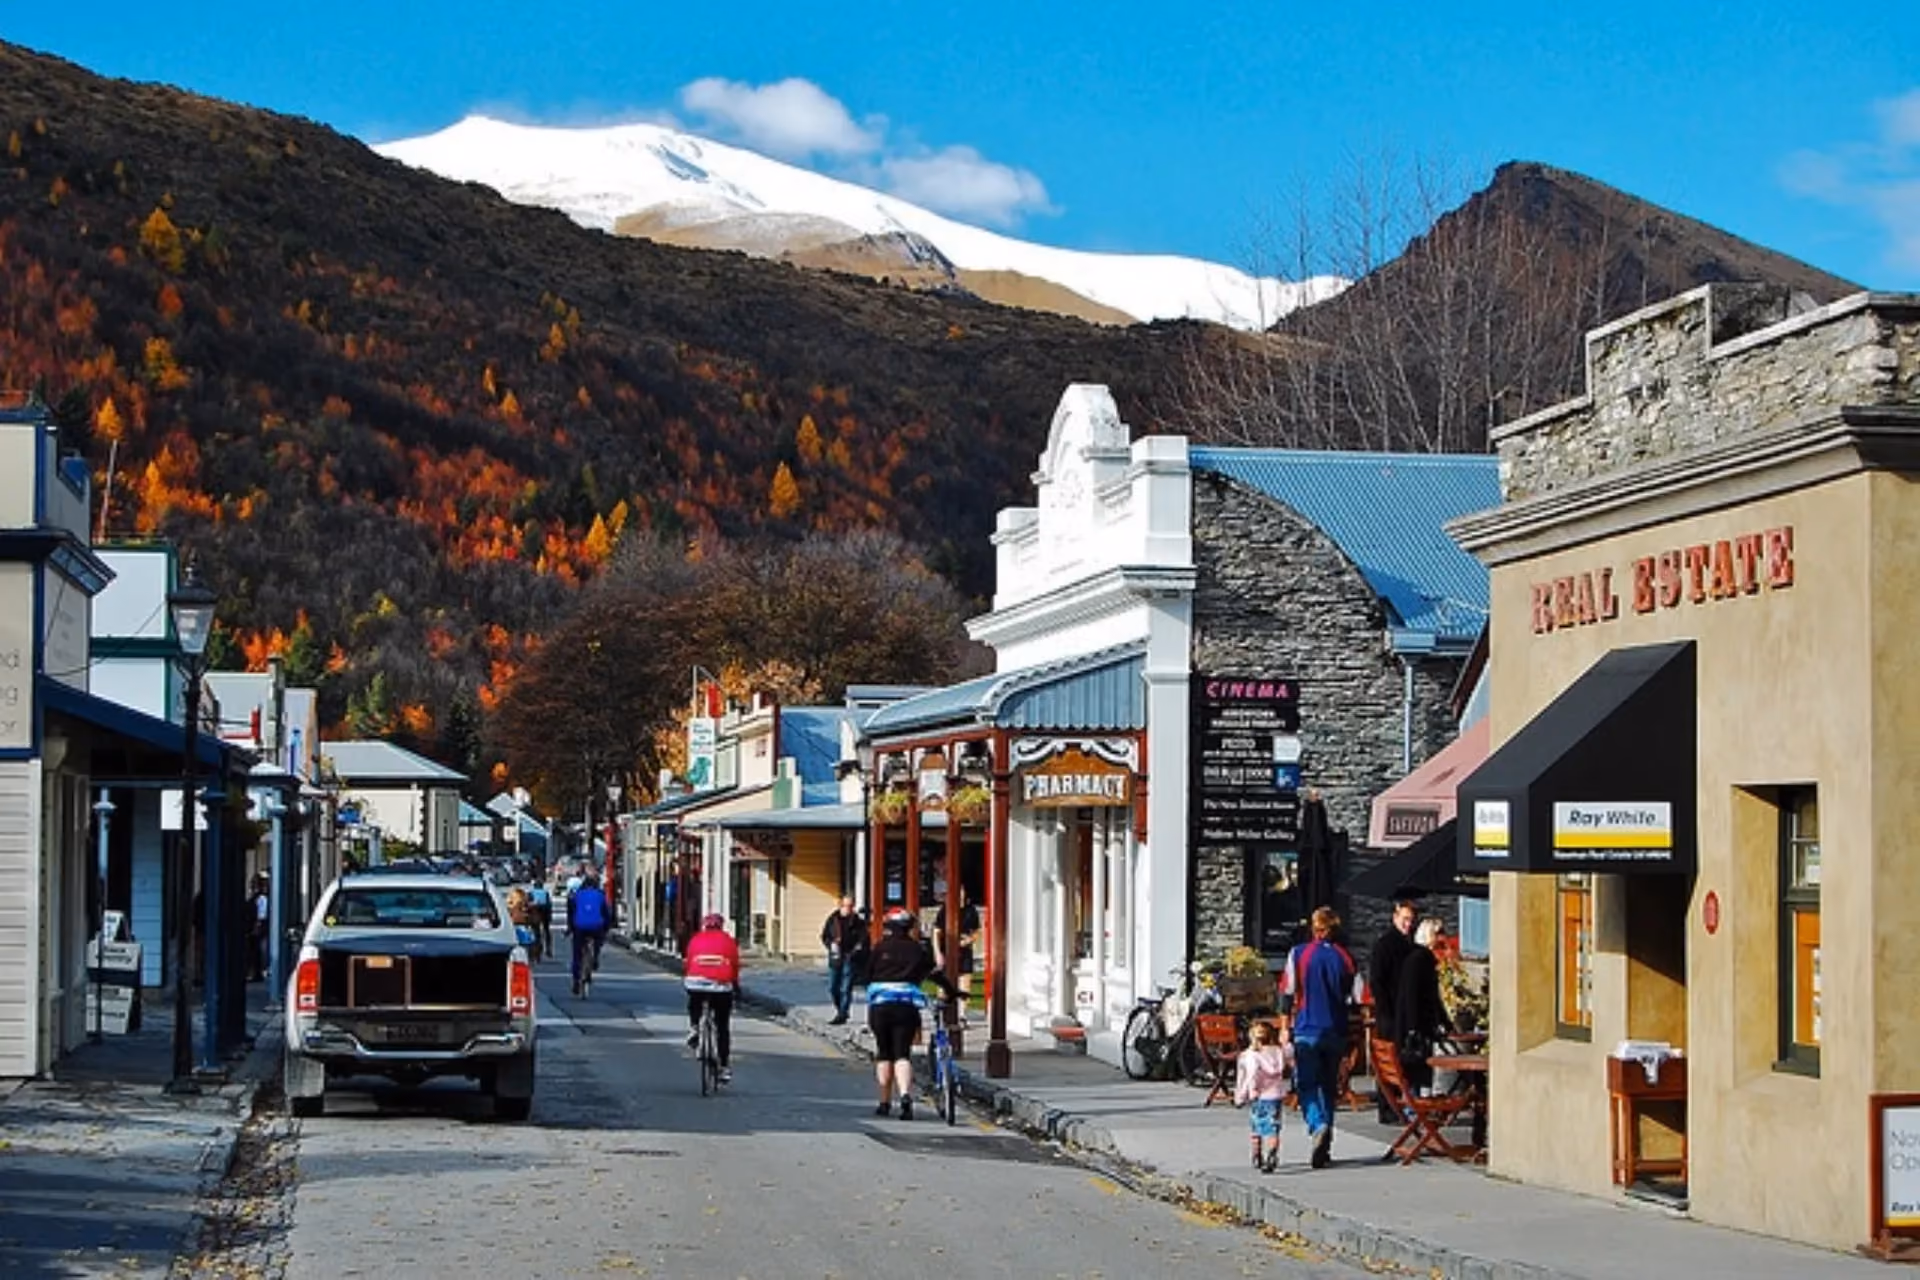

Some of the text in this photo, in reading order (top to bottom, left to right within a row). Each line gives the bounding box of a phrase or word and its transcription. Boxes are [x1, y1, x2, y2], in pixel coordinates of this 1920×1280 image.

[1530, 526, 1794, 634] REAL ESTATE
[1206, 681, 1289, 698] CINEMA
[1023, 774, 1127, 801] PHARMACY
[1568, 810, 1657, 828] Ray White
[1891, 1130, 1920, 1147] No
[1891, 1153, 1920, 1171] Op
